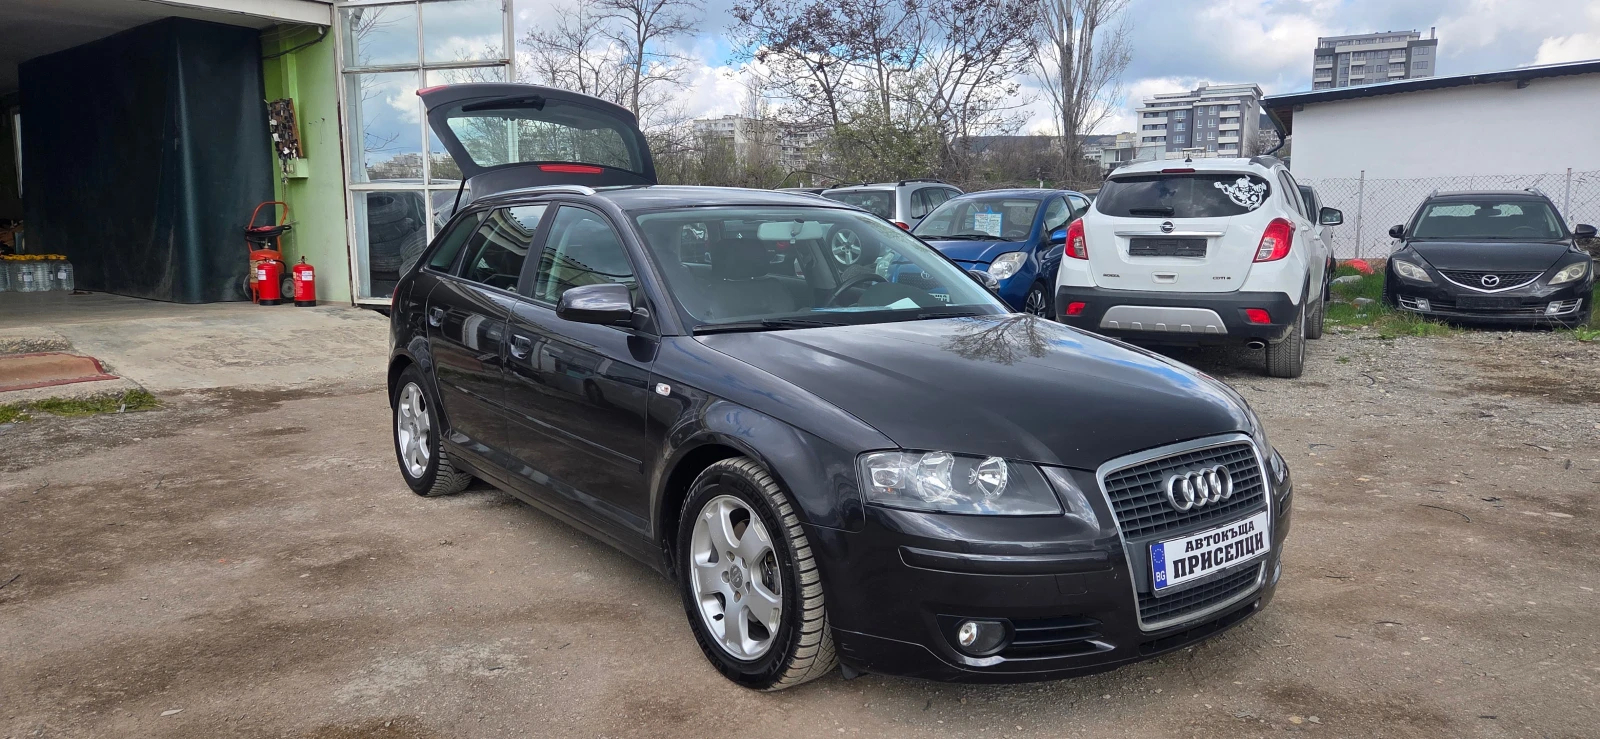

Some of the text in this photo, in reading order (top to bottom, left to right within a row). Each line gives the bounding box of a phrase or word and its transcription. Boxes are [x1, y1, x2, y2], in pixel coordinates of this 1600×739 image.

[1185, 521, 1255, 553] АВТОКЪЩА
[1173, 531, 1264, 580] ПРИСЕЛЦИ
[1156, 570, 1166, 582] BG
